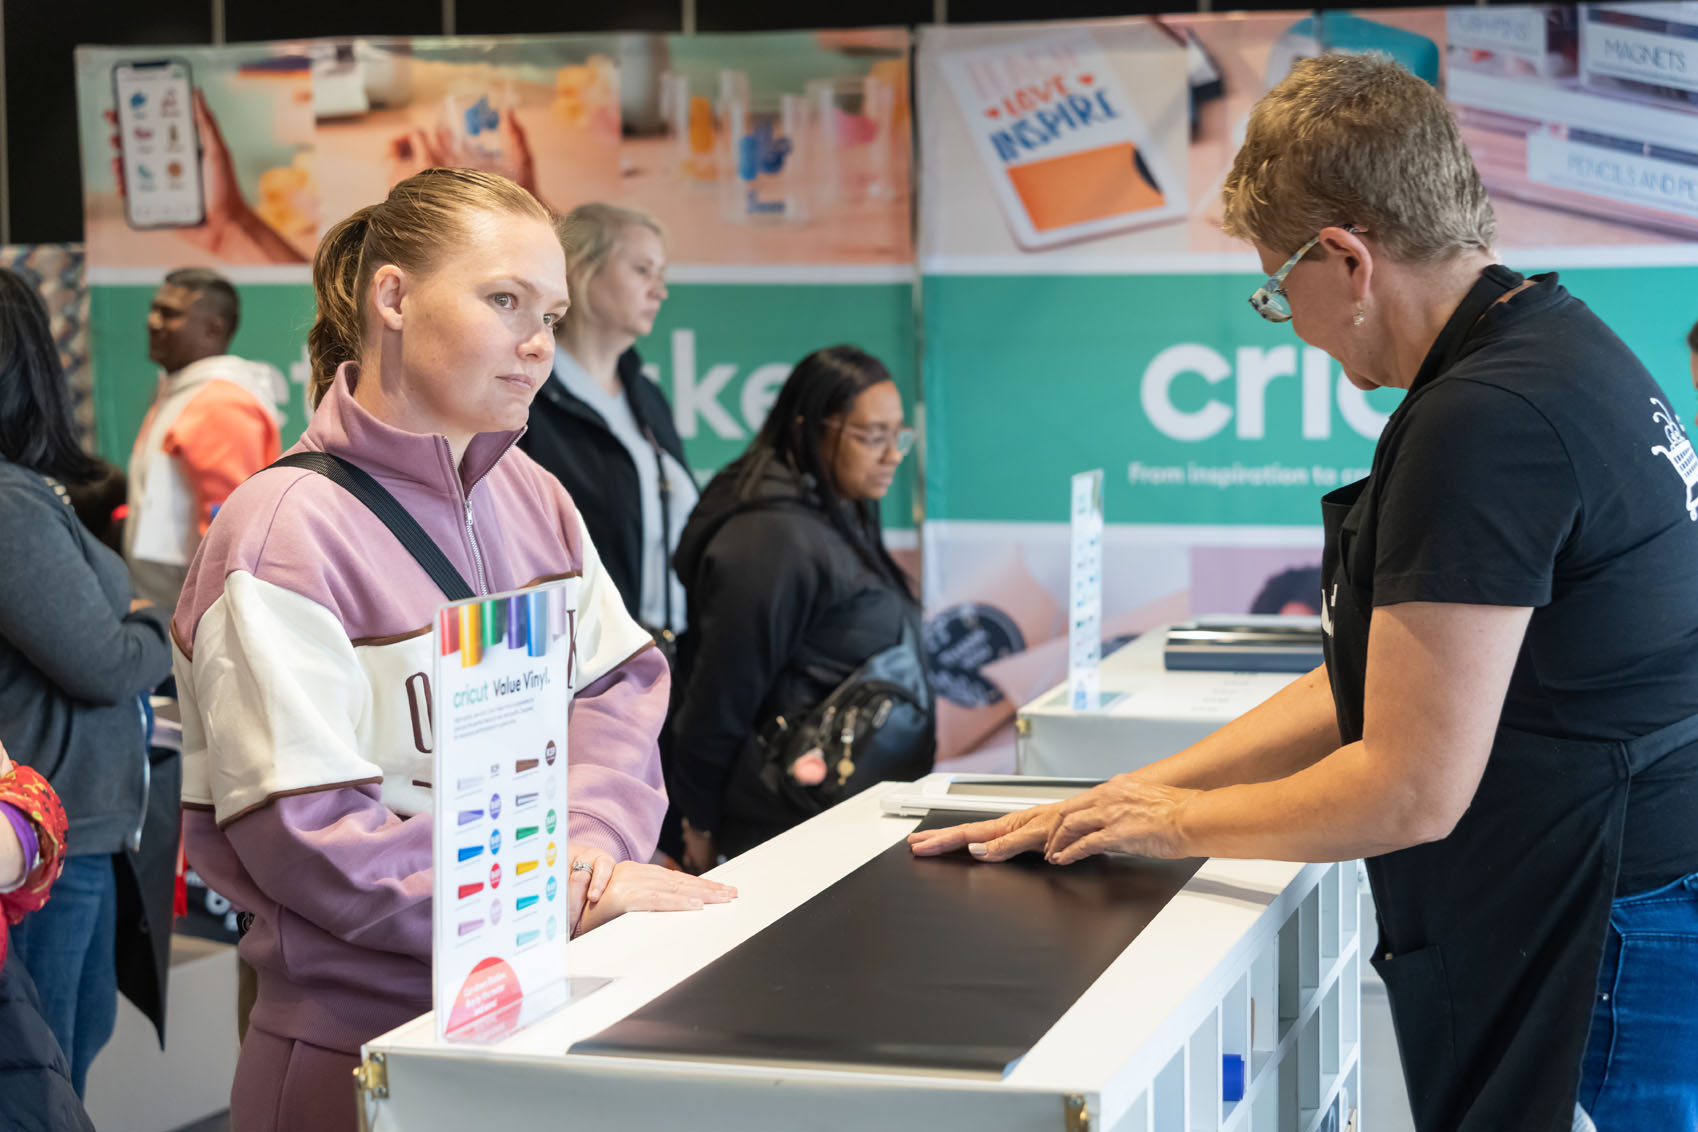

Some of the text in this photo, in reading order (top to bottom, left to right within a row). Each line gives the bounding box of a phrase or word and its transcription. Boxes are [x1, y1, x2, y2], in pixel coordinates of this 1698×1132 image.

[1604, 37, 1686, 72] MAGNETS
[1128, 461, 1186, 486] From
[1188, 461, 1309, 492] inspiration
[1312, 465, 1338, 486] to
[453, 682, 489, 708] cricut
[493, 675, 521, 697] Value
